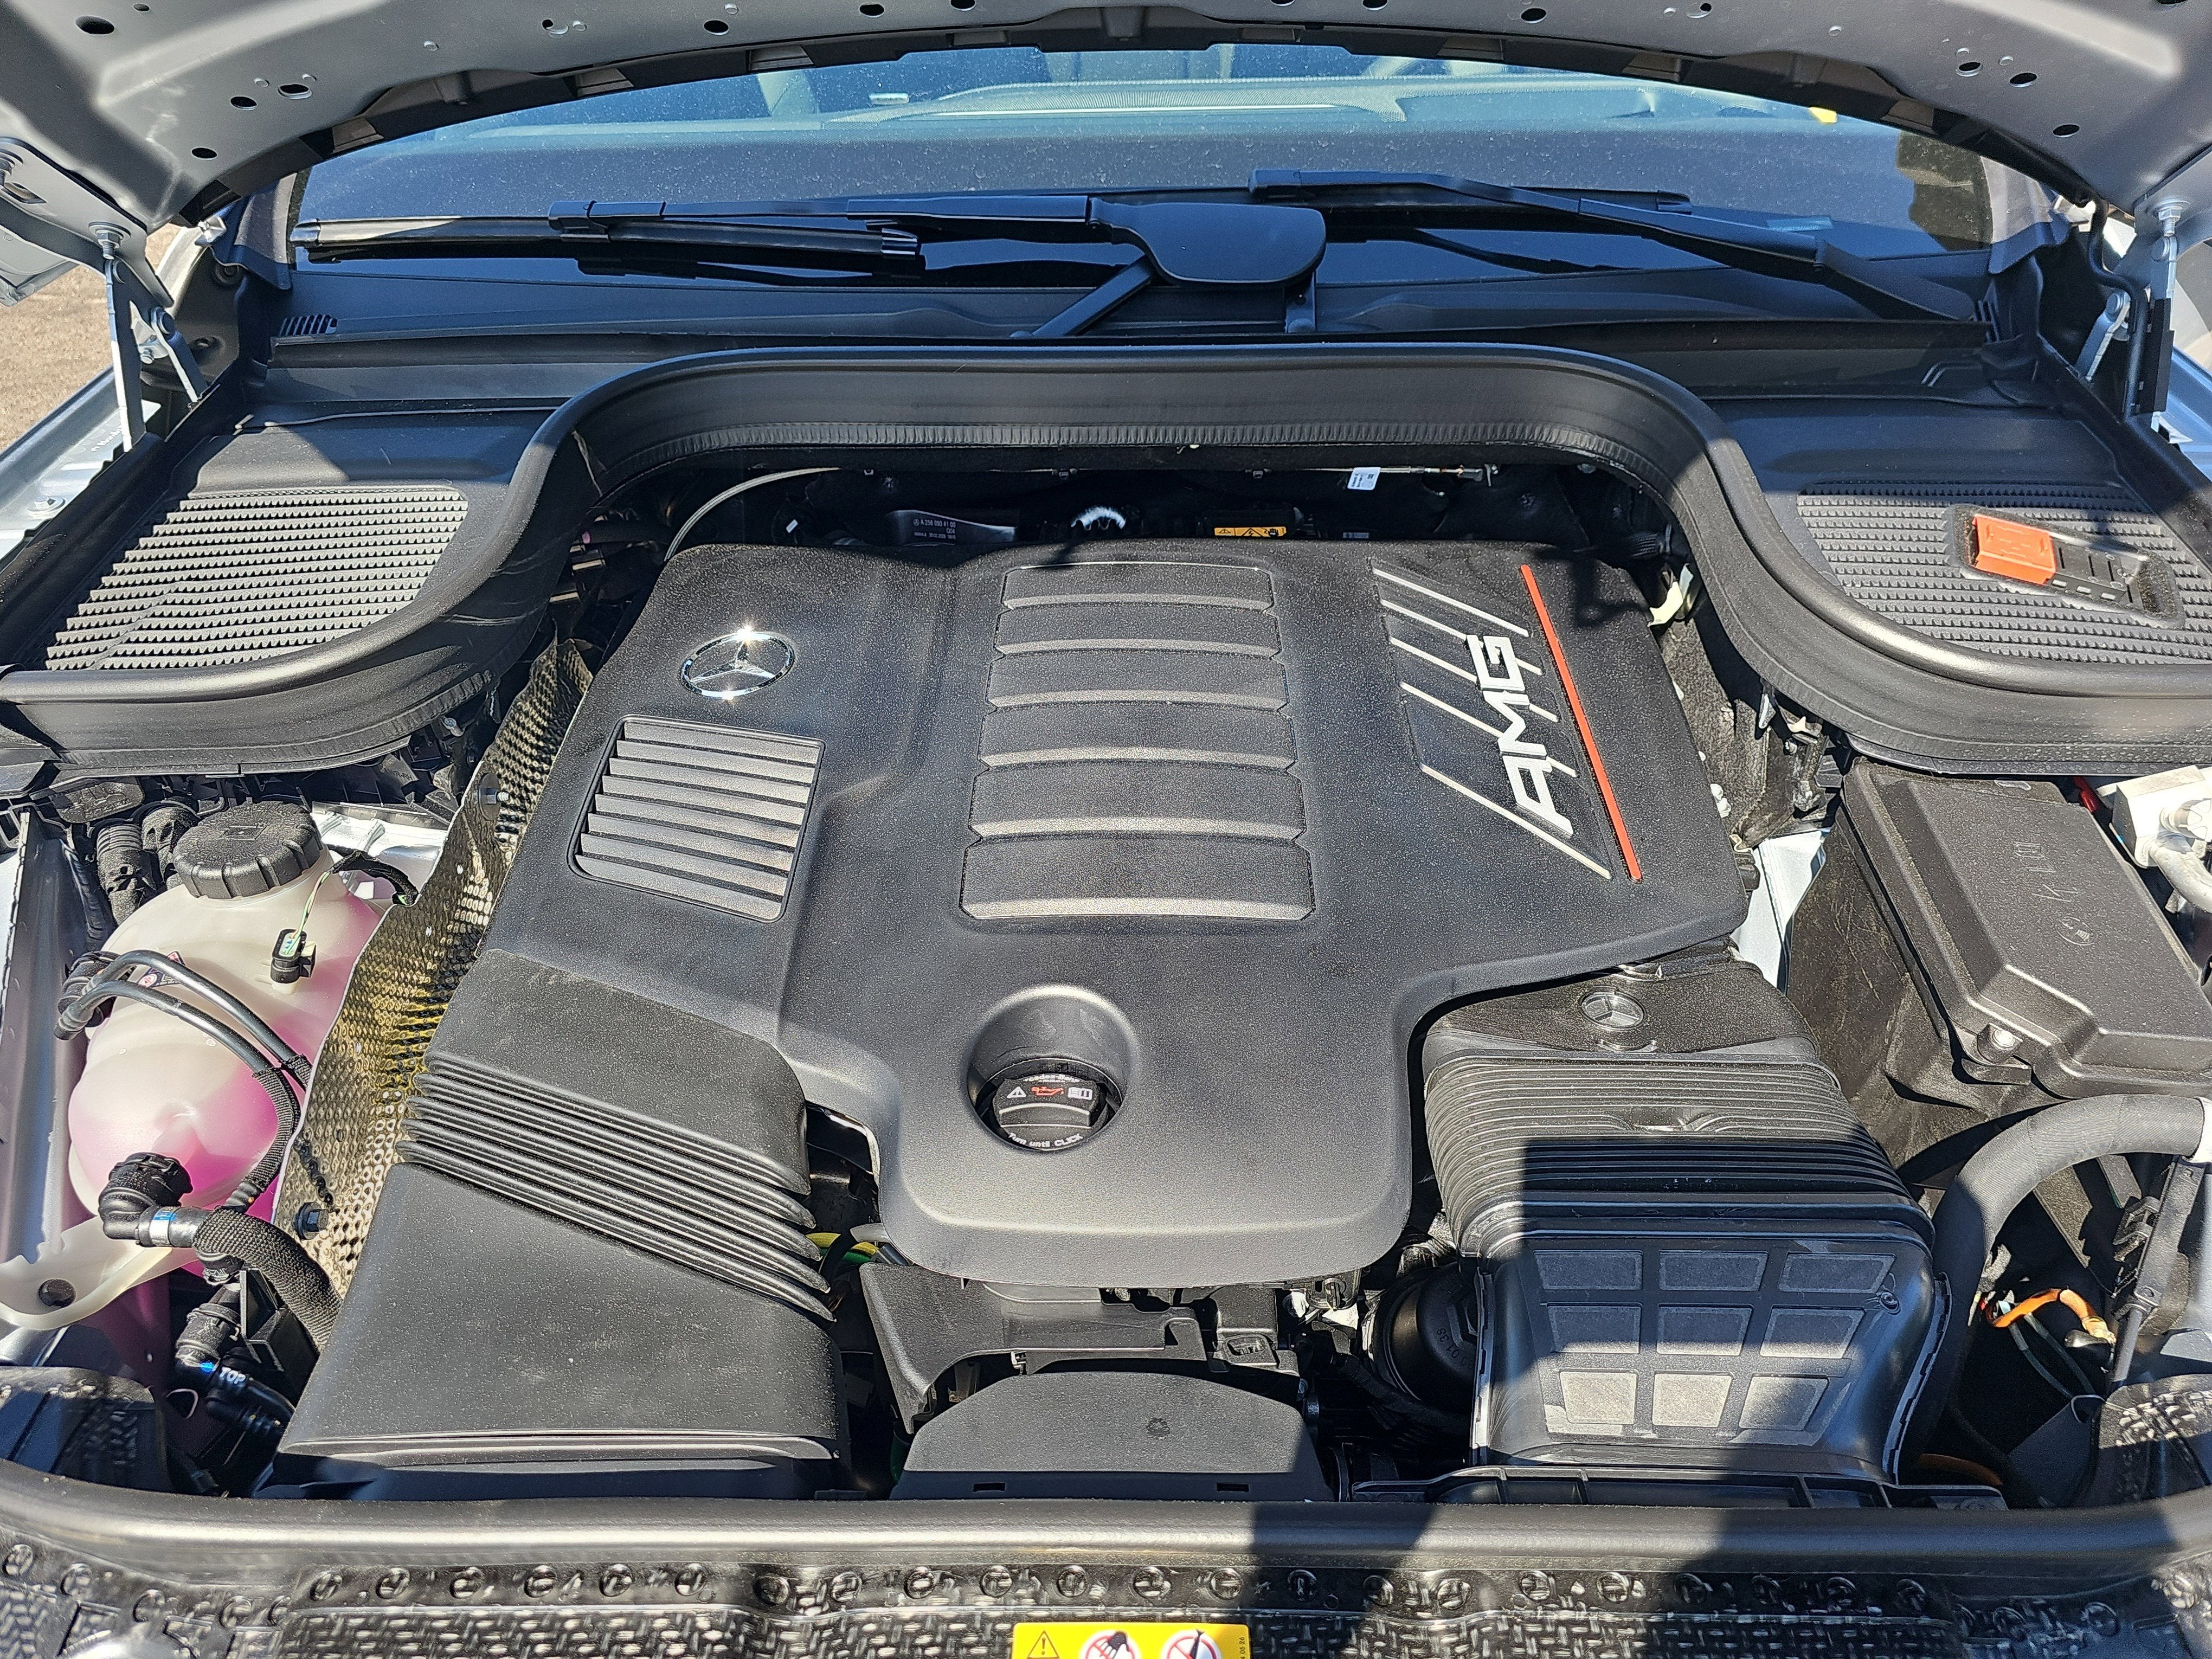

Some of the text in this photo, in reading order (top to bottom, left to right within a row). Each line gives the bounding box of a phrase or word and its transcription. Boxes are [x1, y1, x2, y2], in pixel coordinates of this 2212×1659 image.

[1466, 634, 1574, 835] AMG
[1008, 1133, 1026, 1145] Turn
[1054, 1133, 1084, 1147] CLICK
[219, 1366, 246, 1385] TOP
